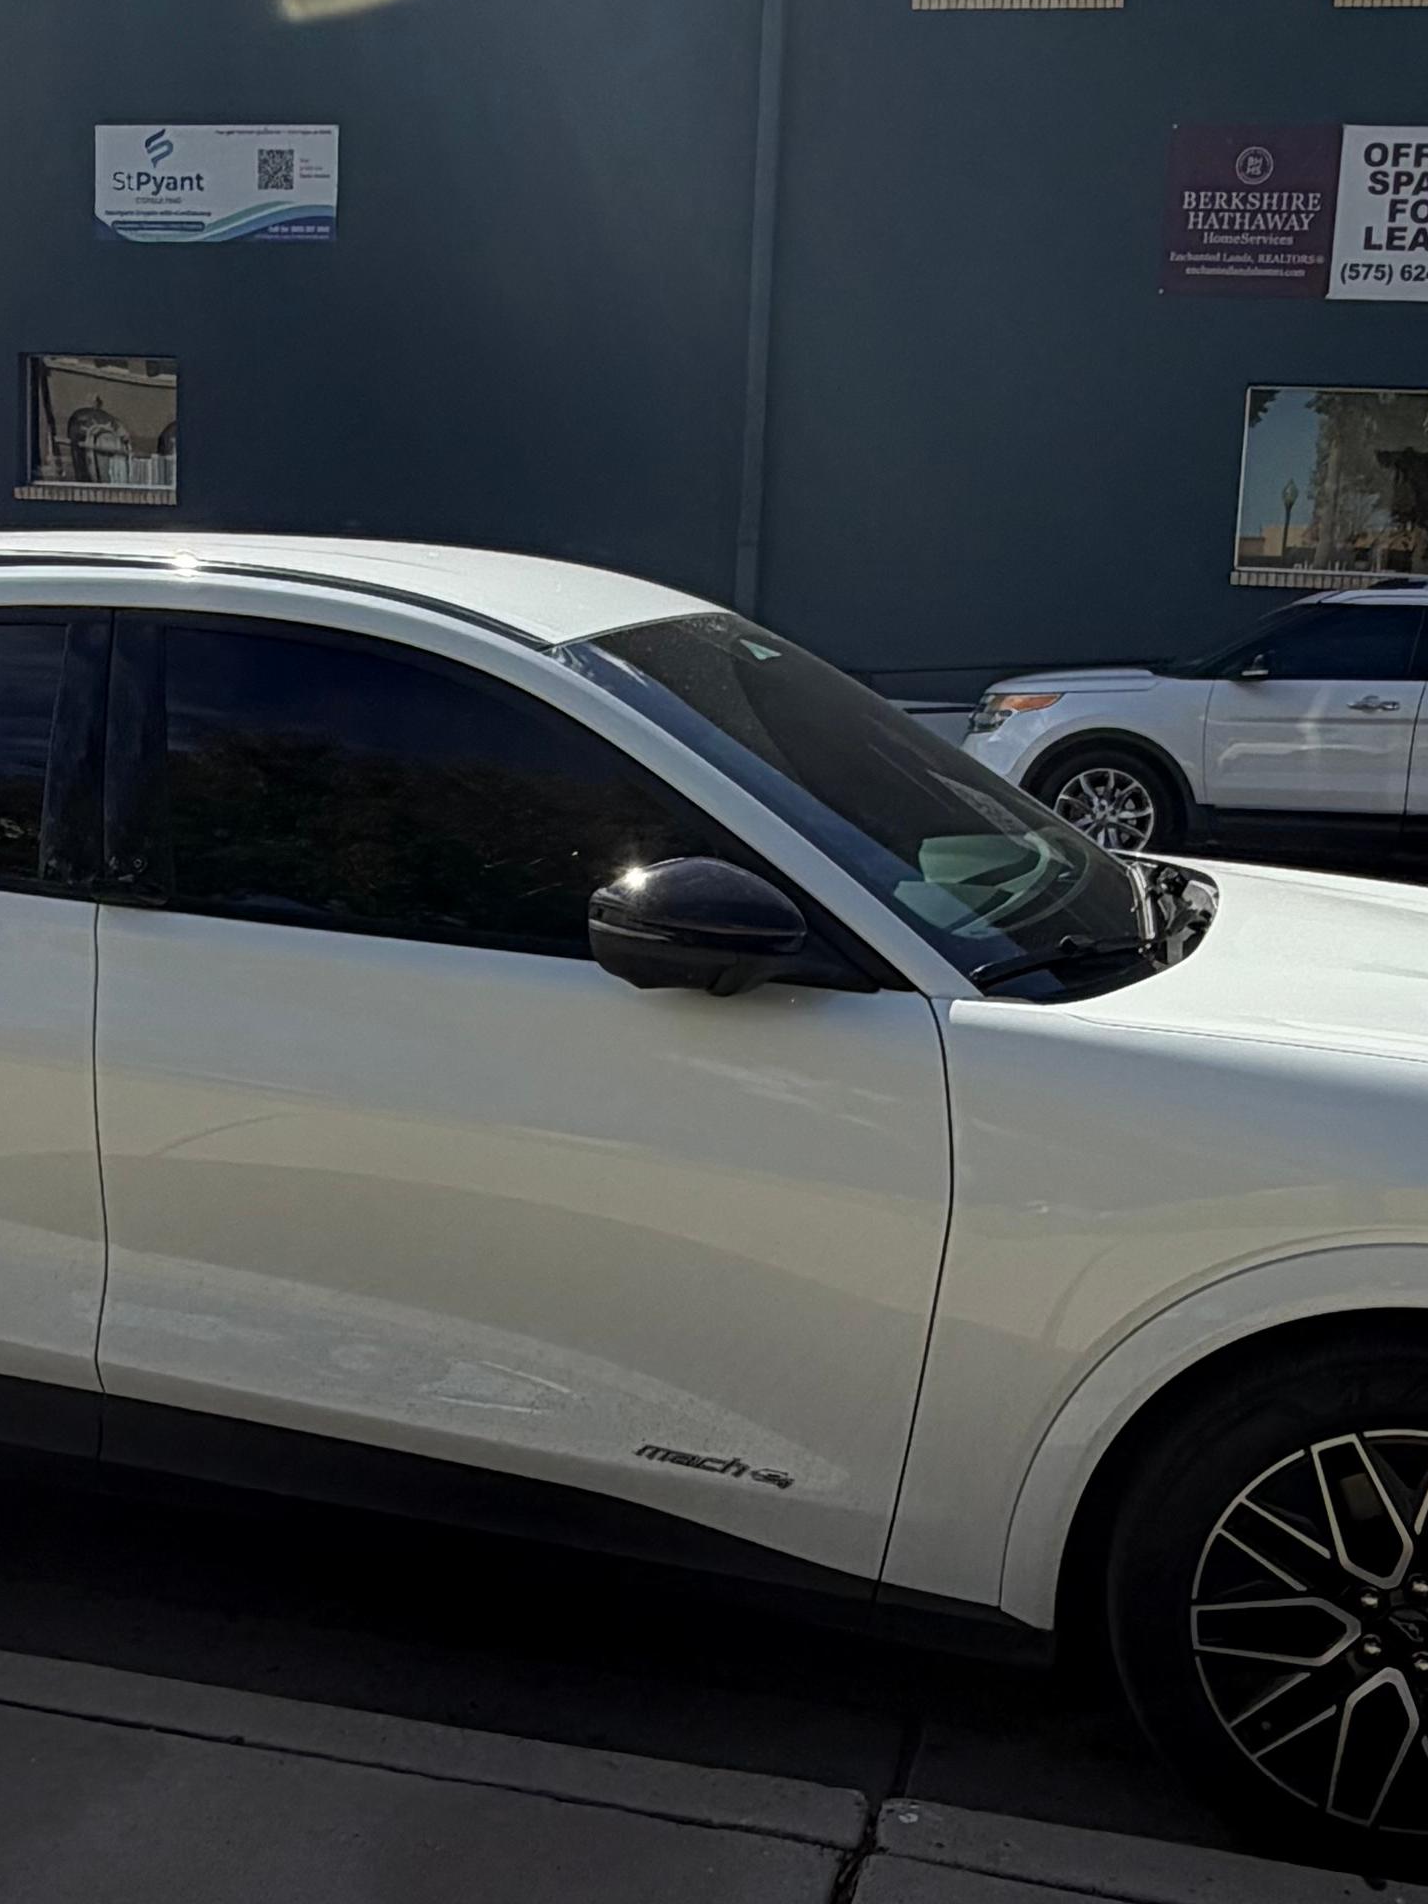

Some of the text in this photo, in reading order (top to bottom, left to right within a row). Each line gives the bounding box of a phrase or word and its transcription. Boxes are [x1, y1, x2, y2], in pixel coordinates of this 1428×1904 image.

[113, 171, 205, 196] StPyant
[1182, 191, 1322, 212] BERKSHIRE
[1187, 211, 1315, 232] HATHAWAY
[1203, 231, 1294, 246] HomeServices
[1340, 263, 1394, 286] (575)
